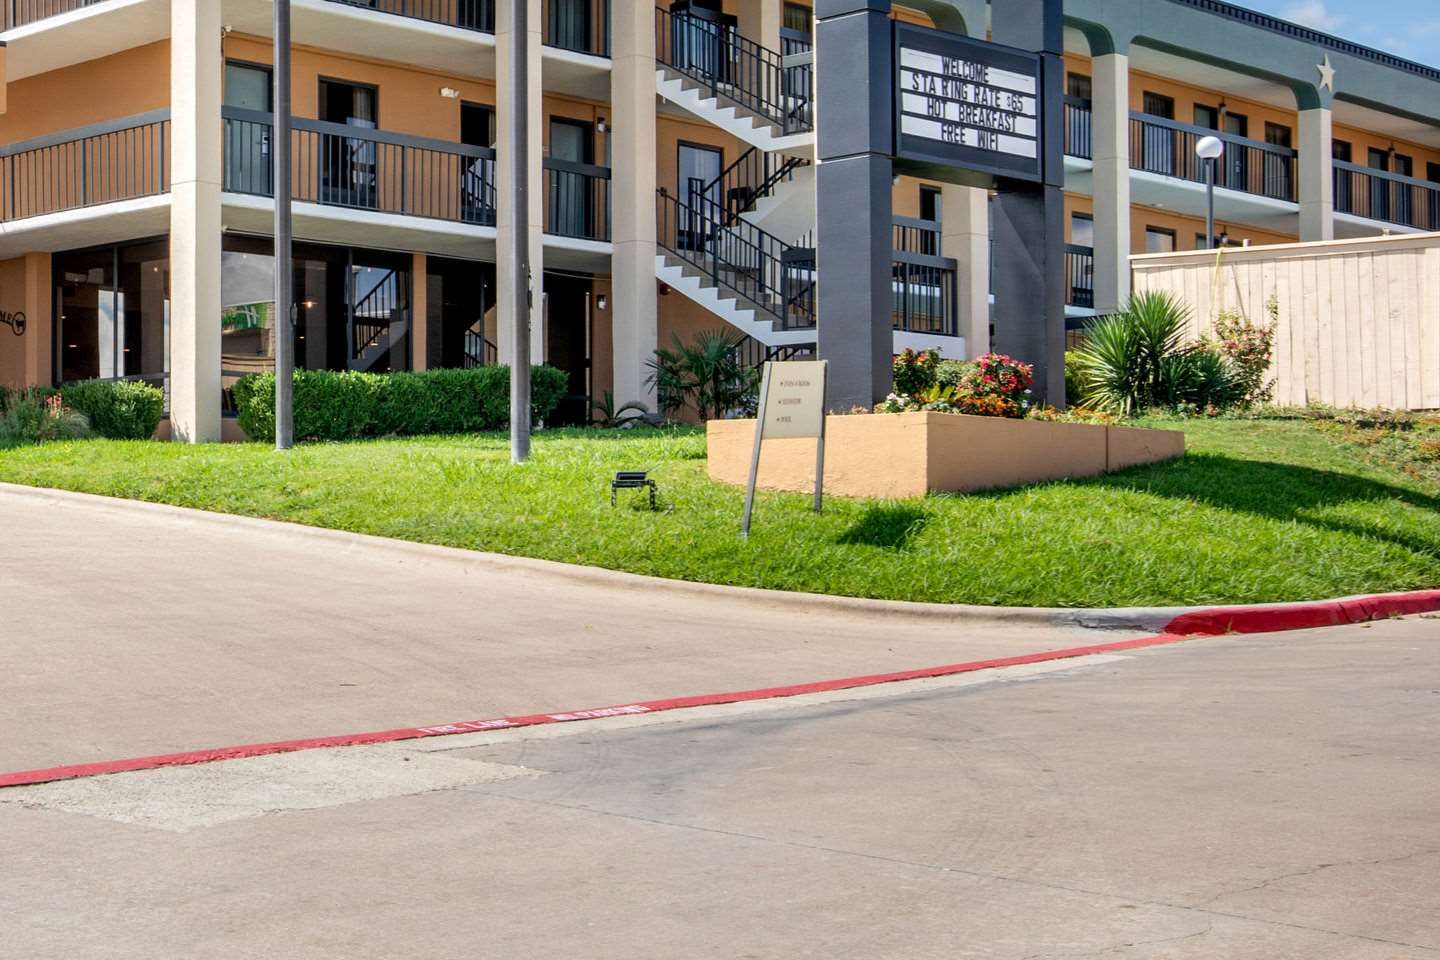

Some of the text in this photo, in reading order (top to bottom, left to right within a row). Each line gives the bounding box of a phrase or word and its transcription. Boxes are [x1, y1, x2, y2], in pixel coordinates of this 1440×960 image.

[941, 55, 990, 83] WELCOME
[974, 84, 1001, 107] RATE
[1006, 96, 1024, 113] $65
[927, 96, 1018, 134] HOT BREAKFAST
[941, 124, 966, 144] FREE
